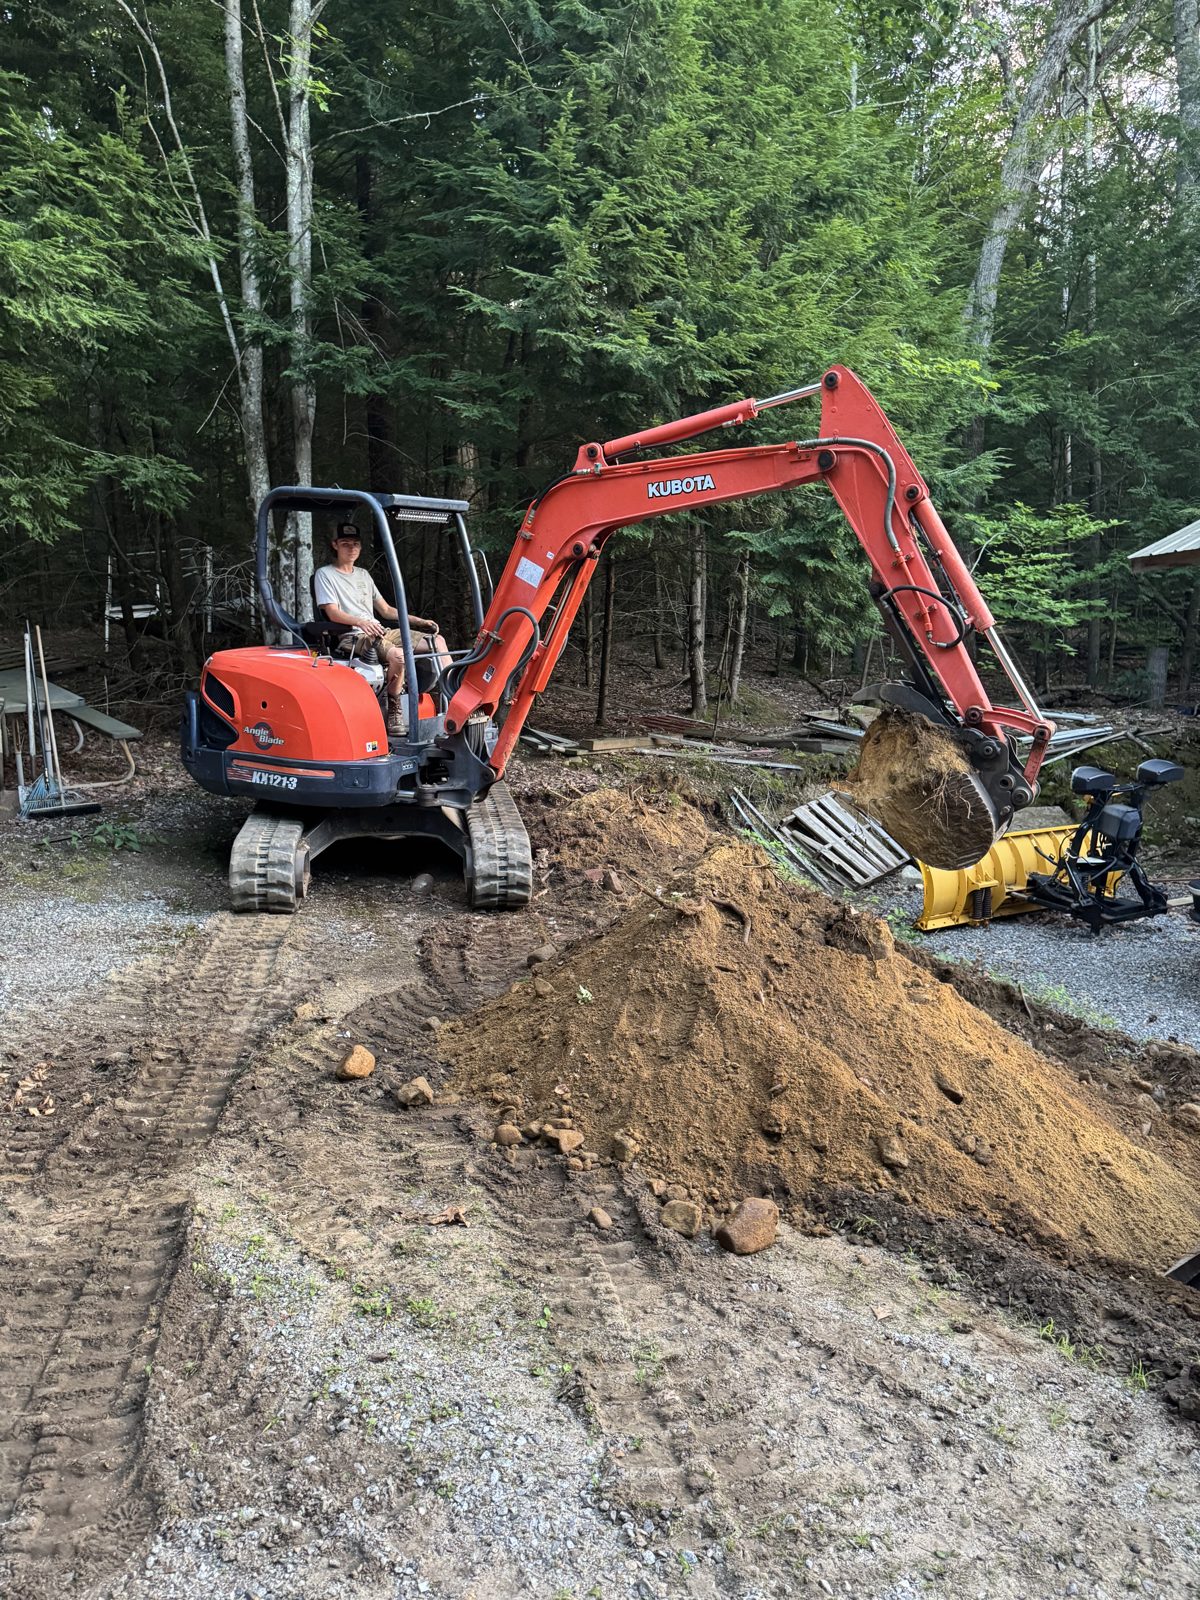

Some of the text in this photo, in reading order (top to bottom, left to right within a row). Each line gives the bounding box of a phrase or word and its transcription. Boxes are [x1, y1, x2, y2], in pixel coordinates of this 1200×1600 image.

[648, 474, 716, 498] KUBOTA
[243, 726, 268, 736] Angle
[259, 735, 284, 744] Blade
